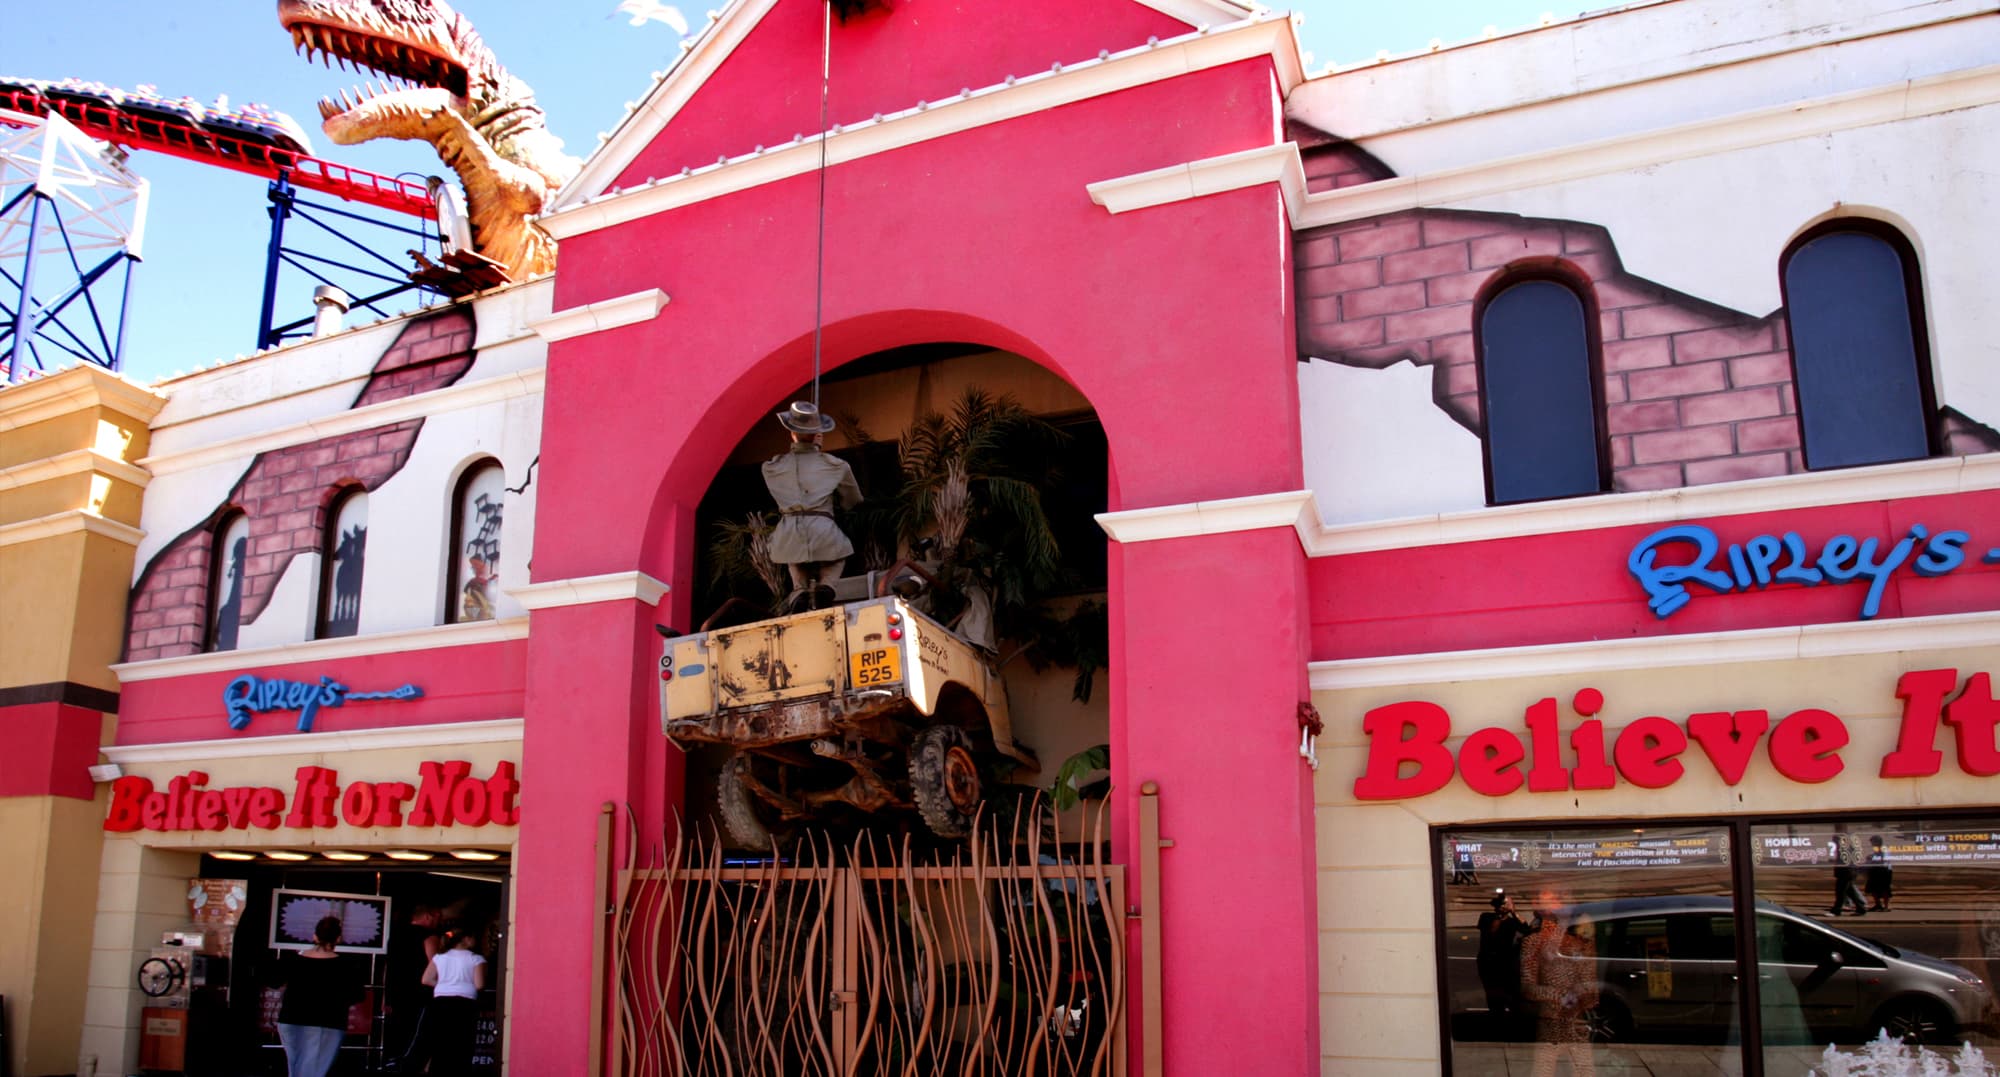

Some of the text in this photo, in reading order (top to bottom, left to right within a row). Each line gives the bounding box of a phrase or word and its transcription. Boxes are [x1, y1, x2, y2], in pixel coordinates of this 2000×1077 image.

[861, 650, 887, 667] RIP
[860, 665, 892, 684] 525
[1354, 668, 2000, 800] Believe It
[103, 761, 520, 832] Believe It or Not
[1765, 838, 1811, 847] HOW BIG
[1955, 833, 1989, 841] FLOORS
[1456, 844, 1482, 852] WHAT
[1615, 849, 1655, 858] exhibition
[1656, 849, 1665, 857] in
[1666, 848, 1679, 856] the
[1770, 849, 1780, 858] IS
[1828, 842, 1837, 857] ?
[1926, 843, 1948, 851] with
[1461, 854, 1469, 862] IS
[1511, 848, 1519, 861] ?
[1577, 859, 1591, 867] Full
[1593, 859, 1602, 867] of
[1603, 858, 1648, 868] fascinating
